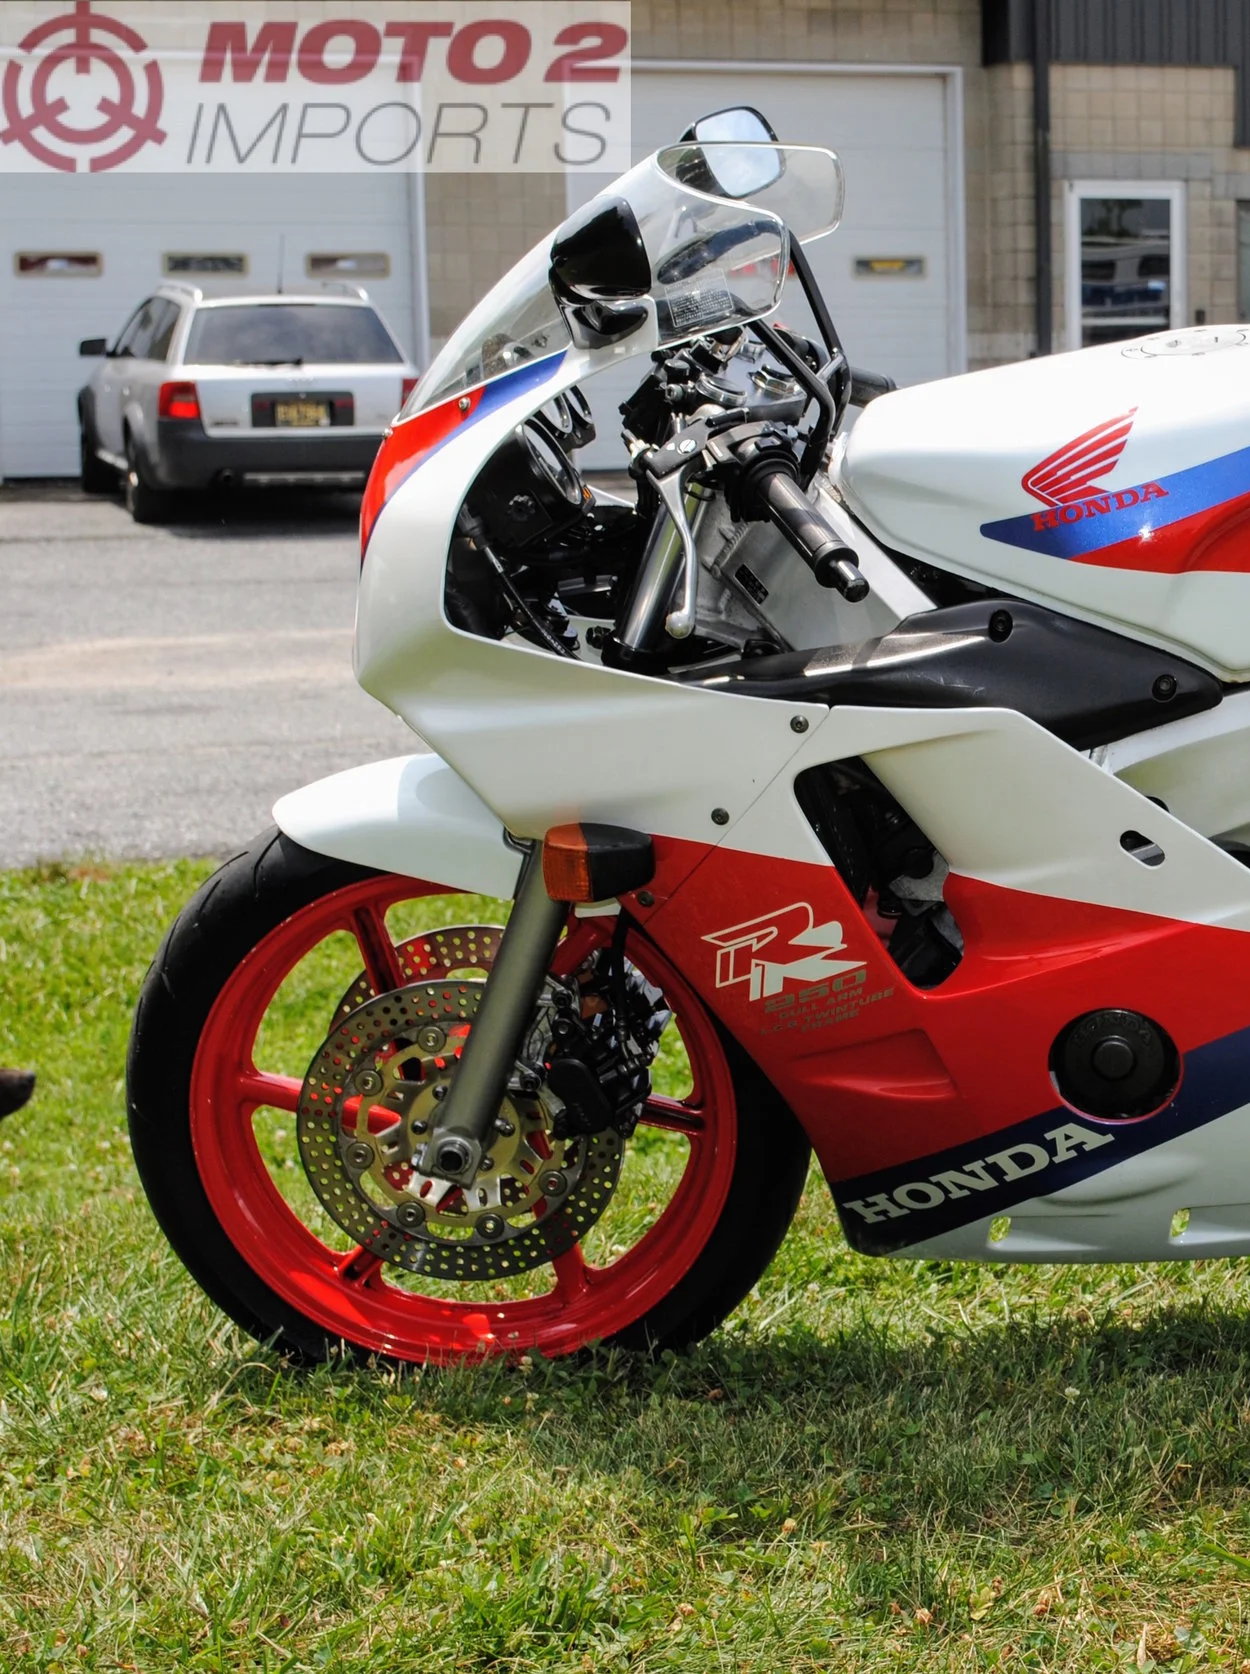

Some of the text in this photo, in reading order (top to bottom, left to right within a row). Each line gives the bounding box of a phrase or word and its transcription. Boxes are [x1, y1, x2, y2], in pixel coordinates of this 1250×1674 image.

[1029, 481, 1170, 533] HONDA
[764, 969, 867, 1014] 250
[843, 1122, 1116, 1225] HONDA
